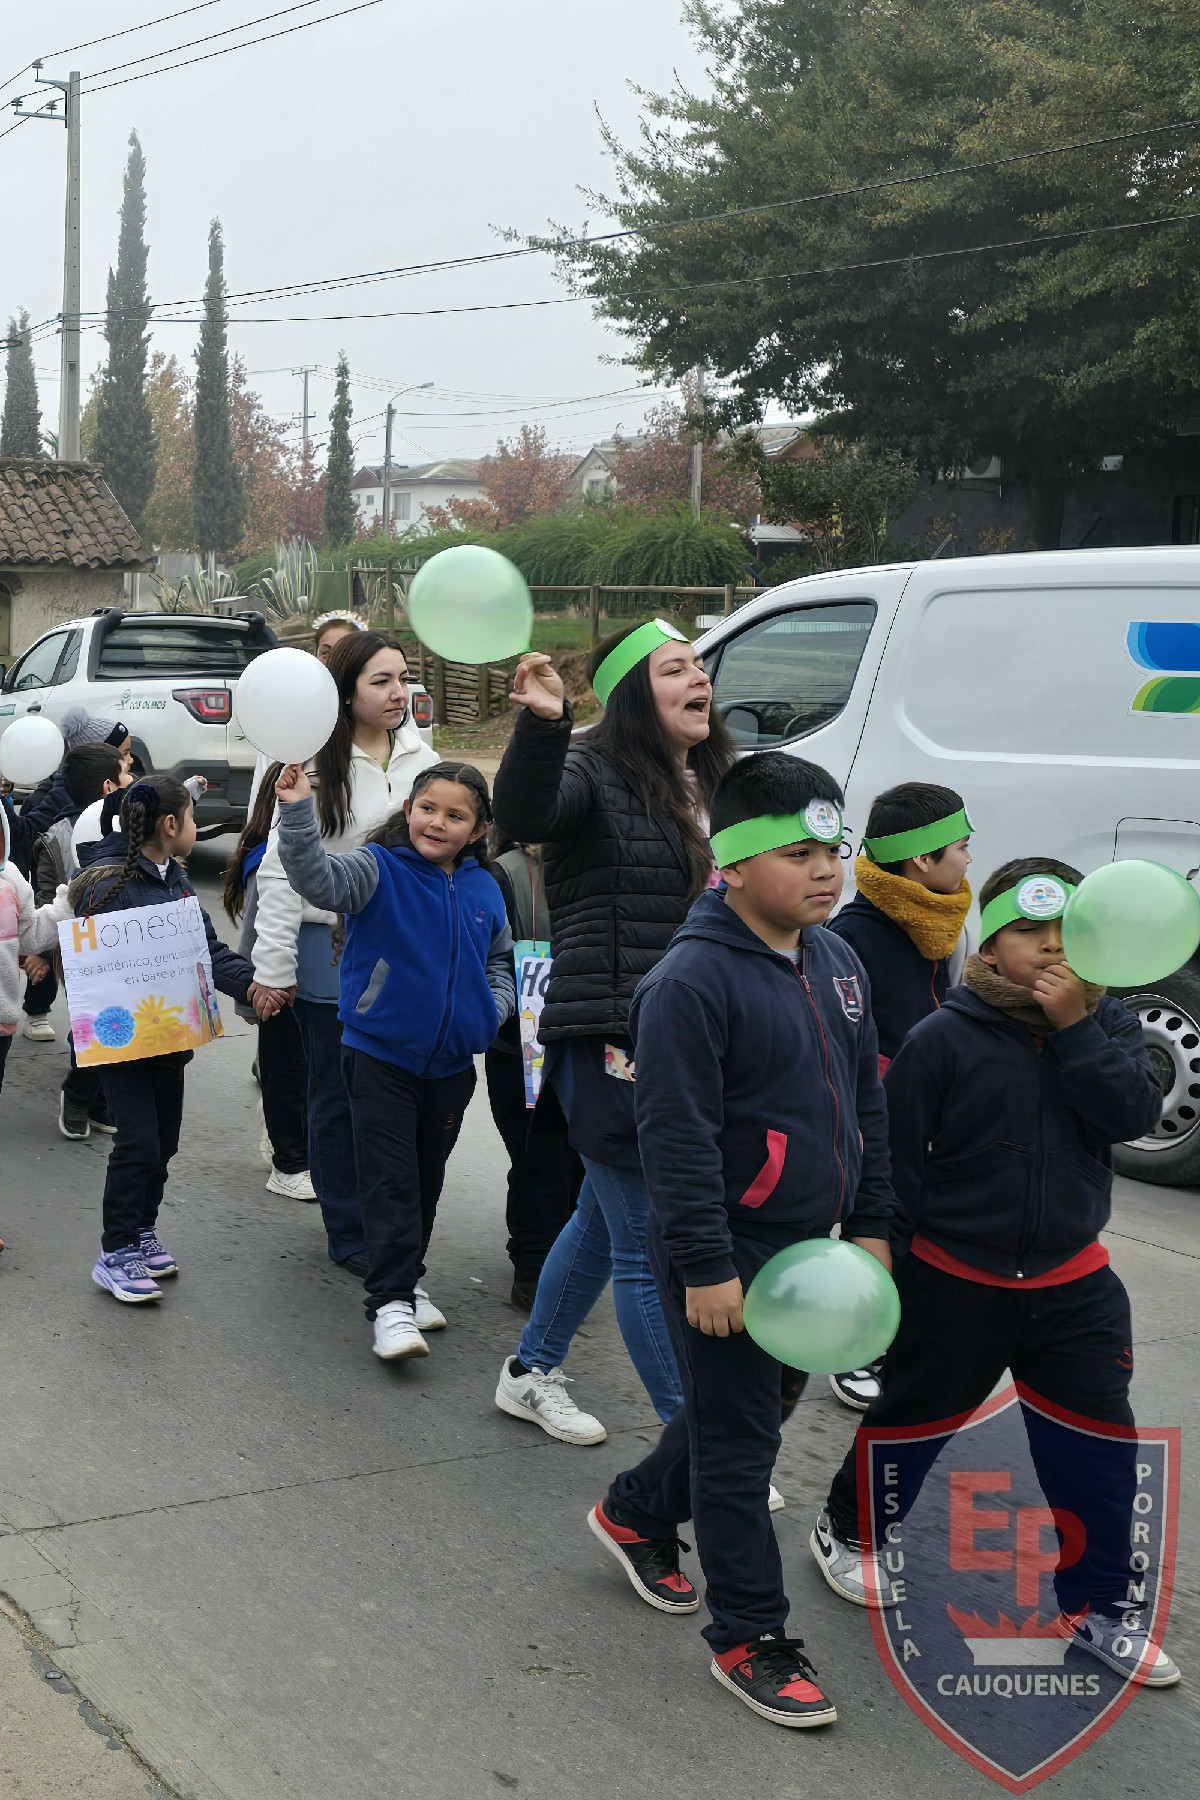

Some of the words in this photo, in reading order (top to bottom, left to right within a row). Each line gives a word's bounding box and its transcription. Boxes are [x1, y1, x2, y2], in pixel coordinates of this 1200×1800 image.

[79, 966, 94, 977] ser
[97, 956, 153, 974] auténtico,
[125, 976, 139, 985] en
[141, 971, 167, 983] base
